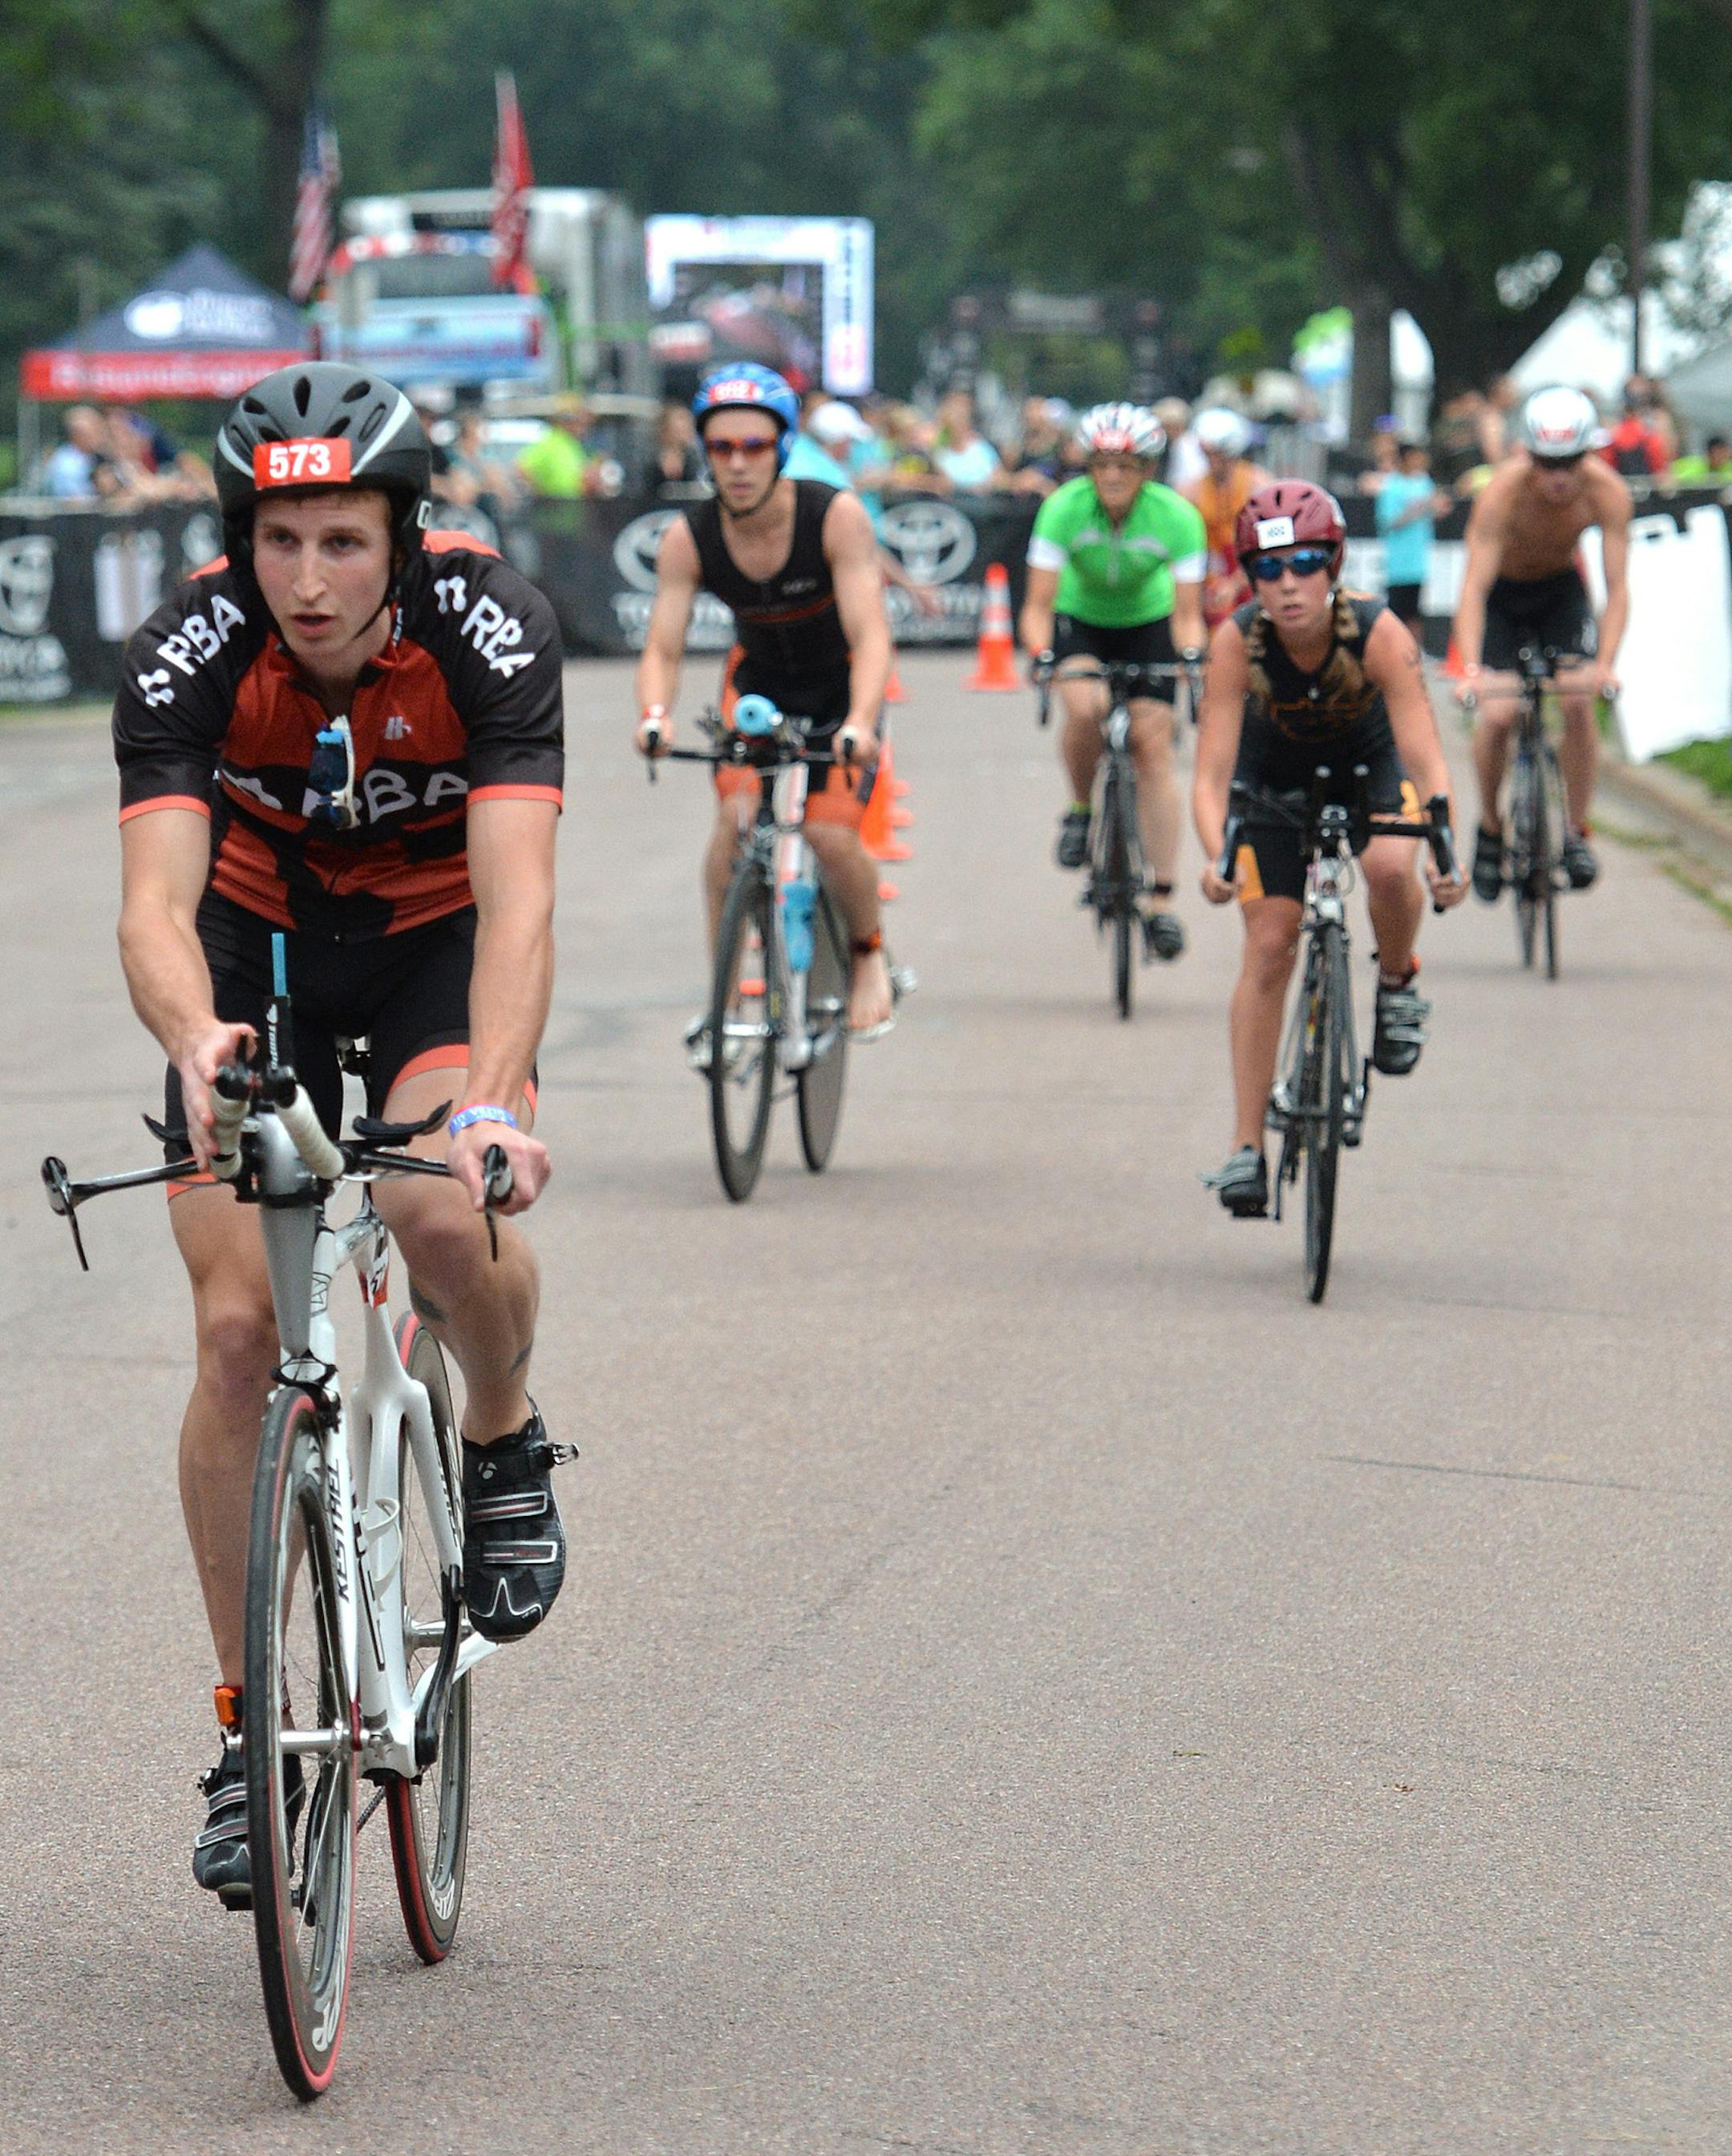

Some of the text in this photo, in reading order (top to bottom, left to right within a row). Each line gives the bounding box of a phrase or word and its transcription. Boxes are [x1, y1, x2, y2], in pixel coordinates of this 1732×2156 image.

[269, 442, 332, 478] 573
[156, 594, 246, 676] RBA
[461, 594, 536, 678] RBA
[326, 1458, 350, 1603] KESTREL
